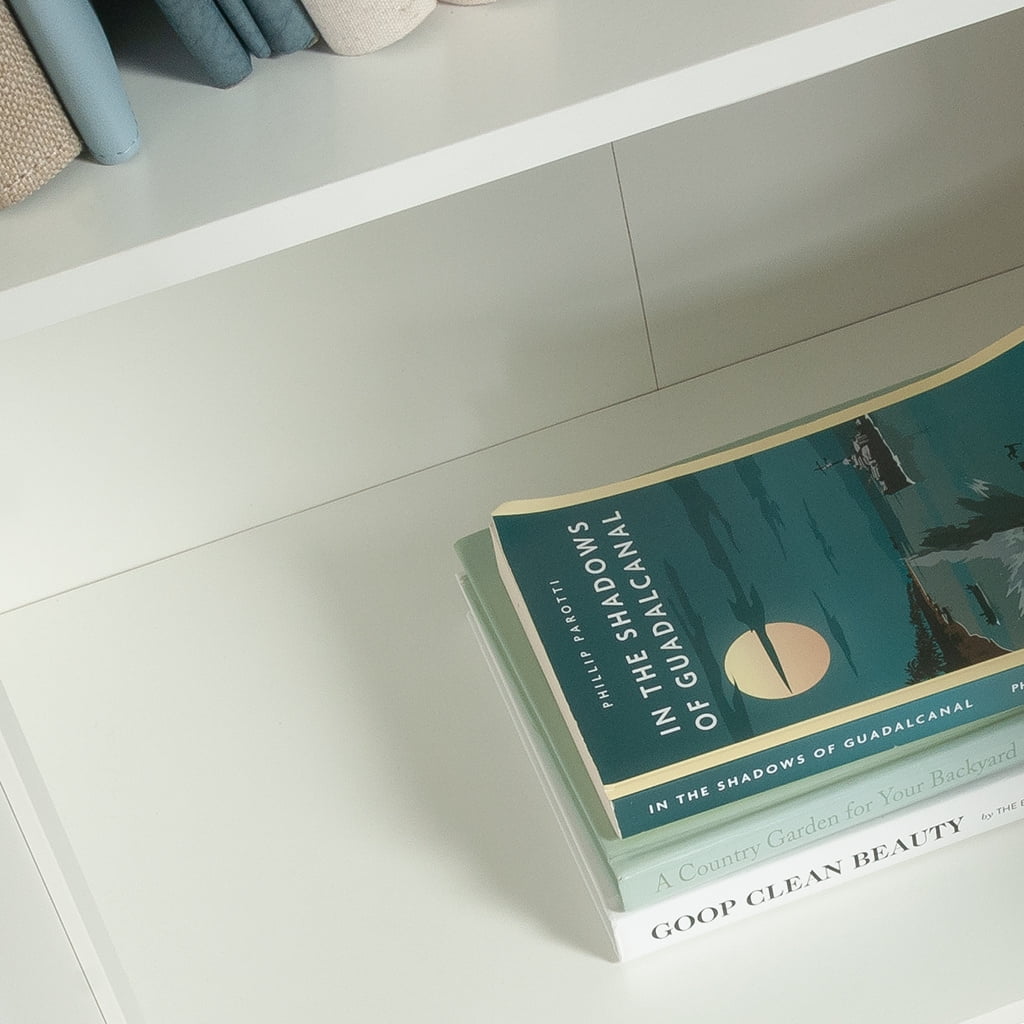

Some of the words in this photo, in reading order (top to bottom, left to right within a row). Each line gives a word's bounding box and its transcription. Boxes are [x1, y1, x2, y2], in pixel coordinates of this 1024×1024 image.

[549, 580, 585, 642] PAROTTI
[567, 521, 638, 642] SHADOWS
[601, 510, 698, 689] GUADALCANAL
[580, 651, 614, 709] PHILLIP
[625, 649, 663, 699] THE
[651, 706, 681, 736] IN
[686, 700, 718, 731] OF
[648, 799, 668, 815] IN
[676, 786, 710, 805] THE
[717, 754, 806, 792] SHADOWS
[813, 744, 836, 758] OF
[844, 699, 974, 748] GUADALCANAL
[655, 872, 673, 893] A
[678, 840, 762, 883] Country
[767, 812, 839, 849] Garden
[845, 799, 873, 820] for
[878, 780, 925, 807] Your
[930, 742, 1017, 788] Backyard
[981, 811, 994, 821] by
[996, 802, 1018, 815] THE
[651, 899, 737, 940] GOOP
[746, 860, 845, 907] CLEAN
[852, 815, 965, 870] BEAUTY
